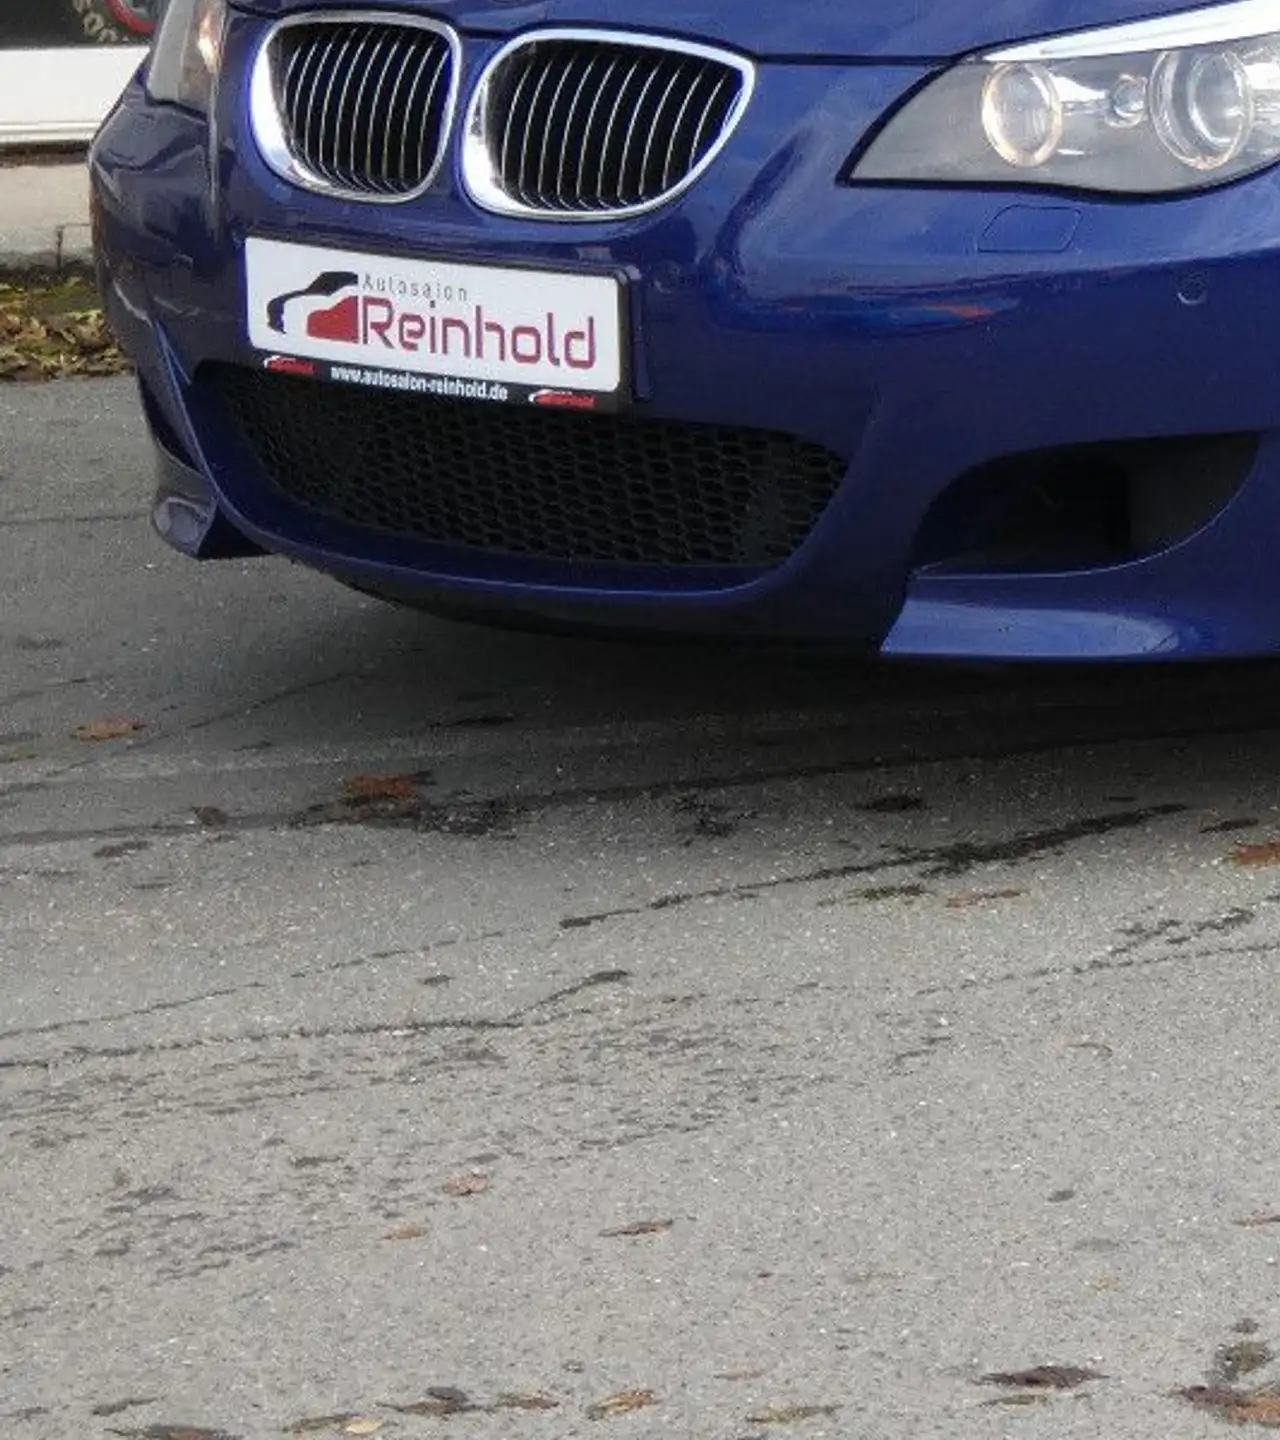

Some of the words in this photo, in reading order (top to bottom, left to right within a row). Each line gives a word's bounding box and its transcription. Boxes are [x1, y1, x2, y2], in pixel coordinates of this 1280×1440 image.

[361, 272, 468, 302] Autosalon
[361, 295, 597, 370] Reinhold
[330, 366, 509, 402] www.autosalon-reinhold.de
